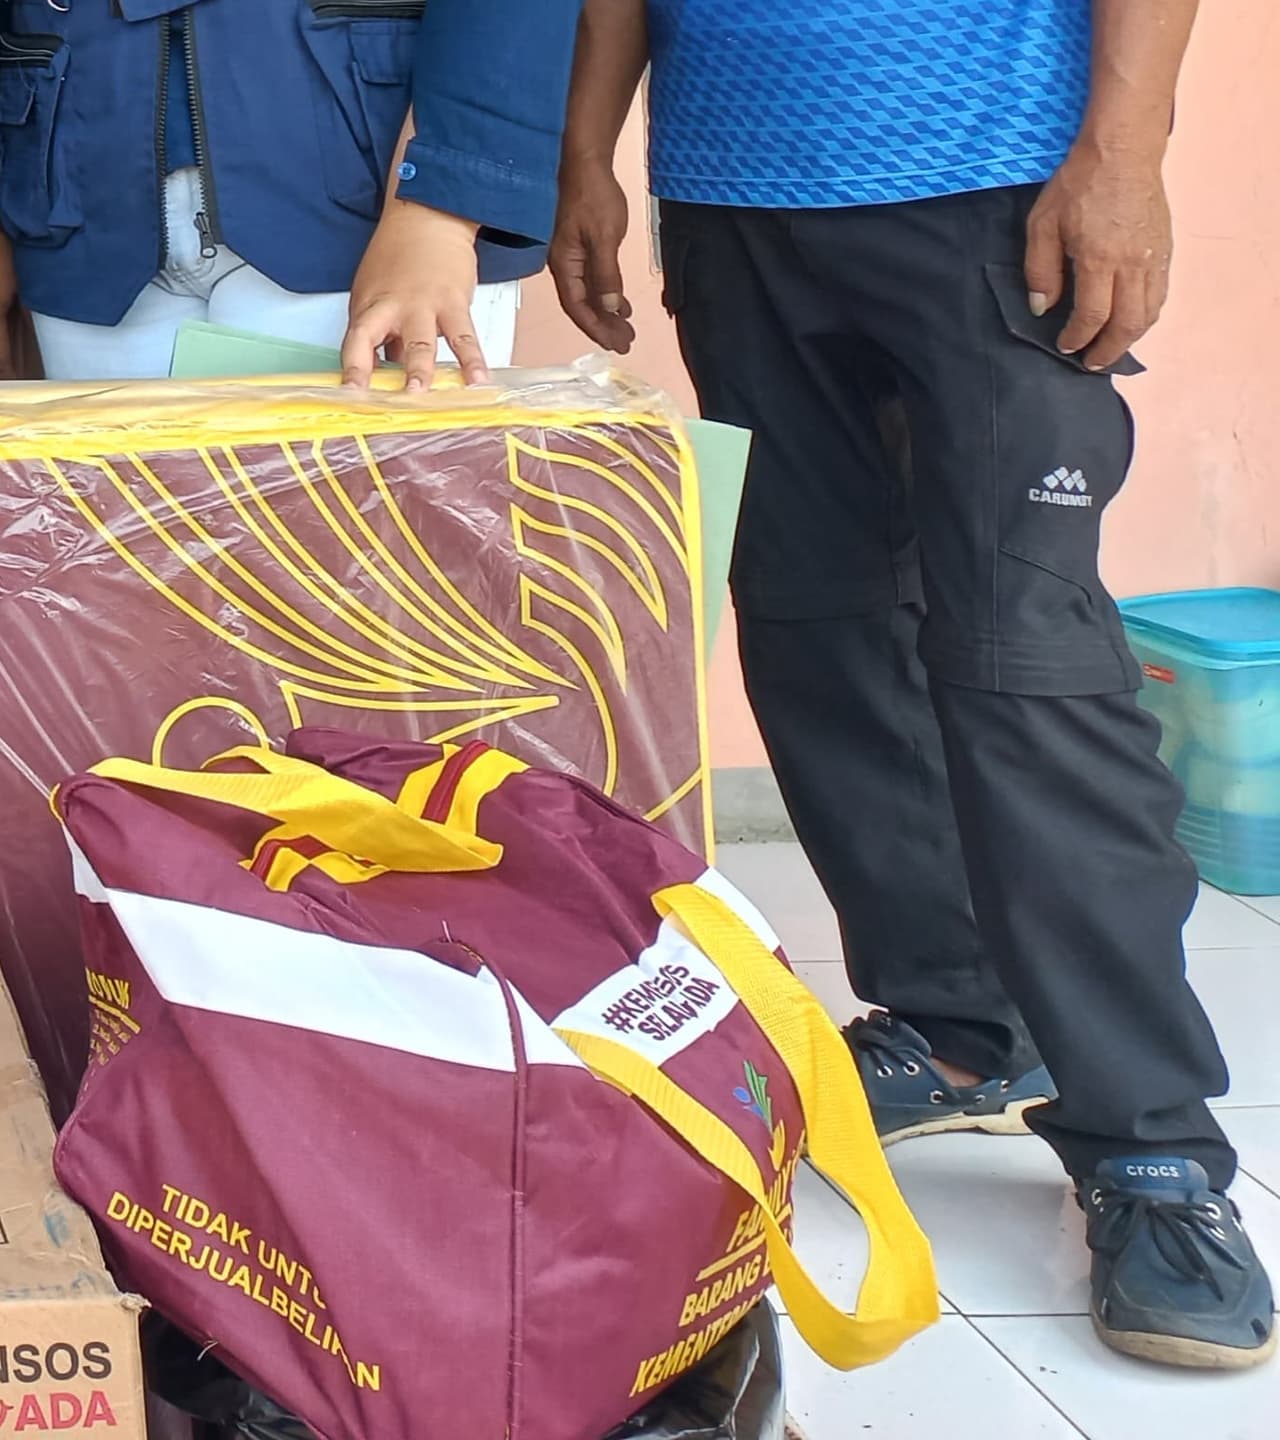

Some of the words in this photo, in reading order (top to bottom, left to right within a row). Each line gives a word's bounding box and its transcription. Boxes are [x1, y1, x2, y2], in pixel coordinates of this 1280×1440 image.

[1125, 1164, 1181, 1178] crocs
[161, 1183, 253, 1254] TIDAK
[257, 1239, 327, 1310] UNT
[106, 1191, 381, 1391] DIPERJUALBELIN
[678, 1254, 762, 1328] BARANG
[14, 1390, 117, 1433] ADA
